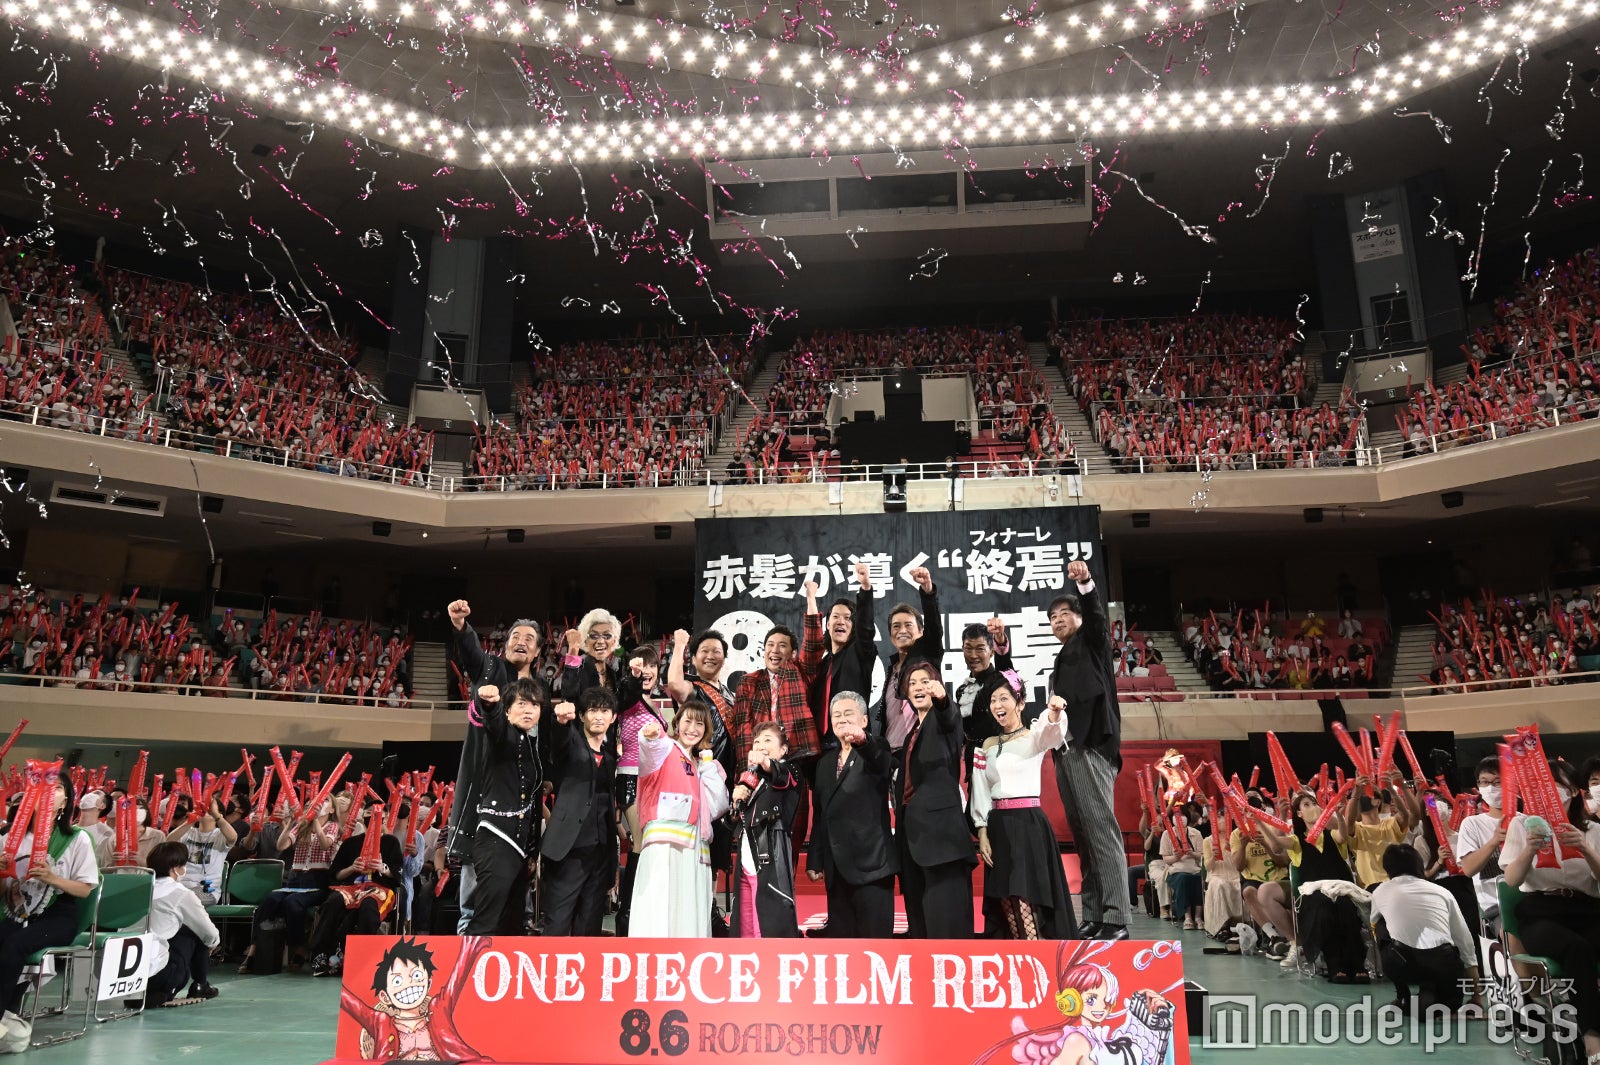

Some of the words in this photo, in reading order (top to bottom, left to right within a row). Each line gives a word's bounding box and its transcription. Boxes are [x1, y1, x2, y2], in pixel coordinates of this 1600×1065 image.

[970, 526, 1051, 546] フィナーレ
[117, 936, 143, 979] D
[109, 976, 143, 997] ブロック
[472, 950, 586, 1005] ONE
[600, 951, 761, 1004] PIECE
[777, 950, 913, 1006] FILM
[931, 953, 1050, 1014] RED
[619, 1008, 690, 1057] 8.6
[698, 1022, 883, 1057] ROADSHOW
